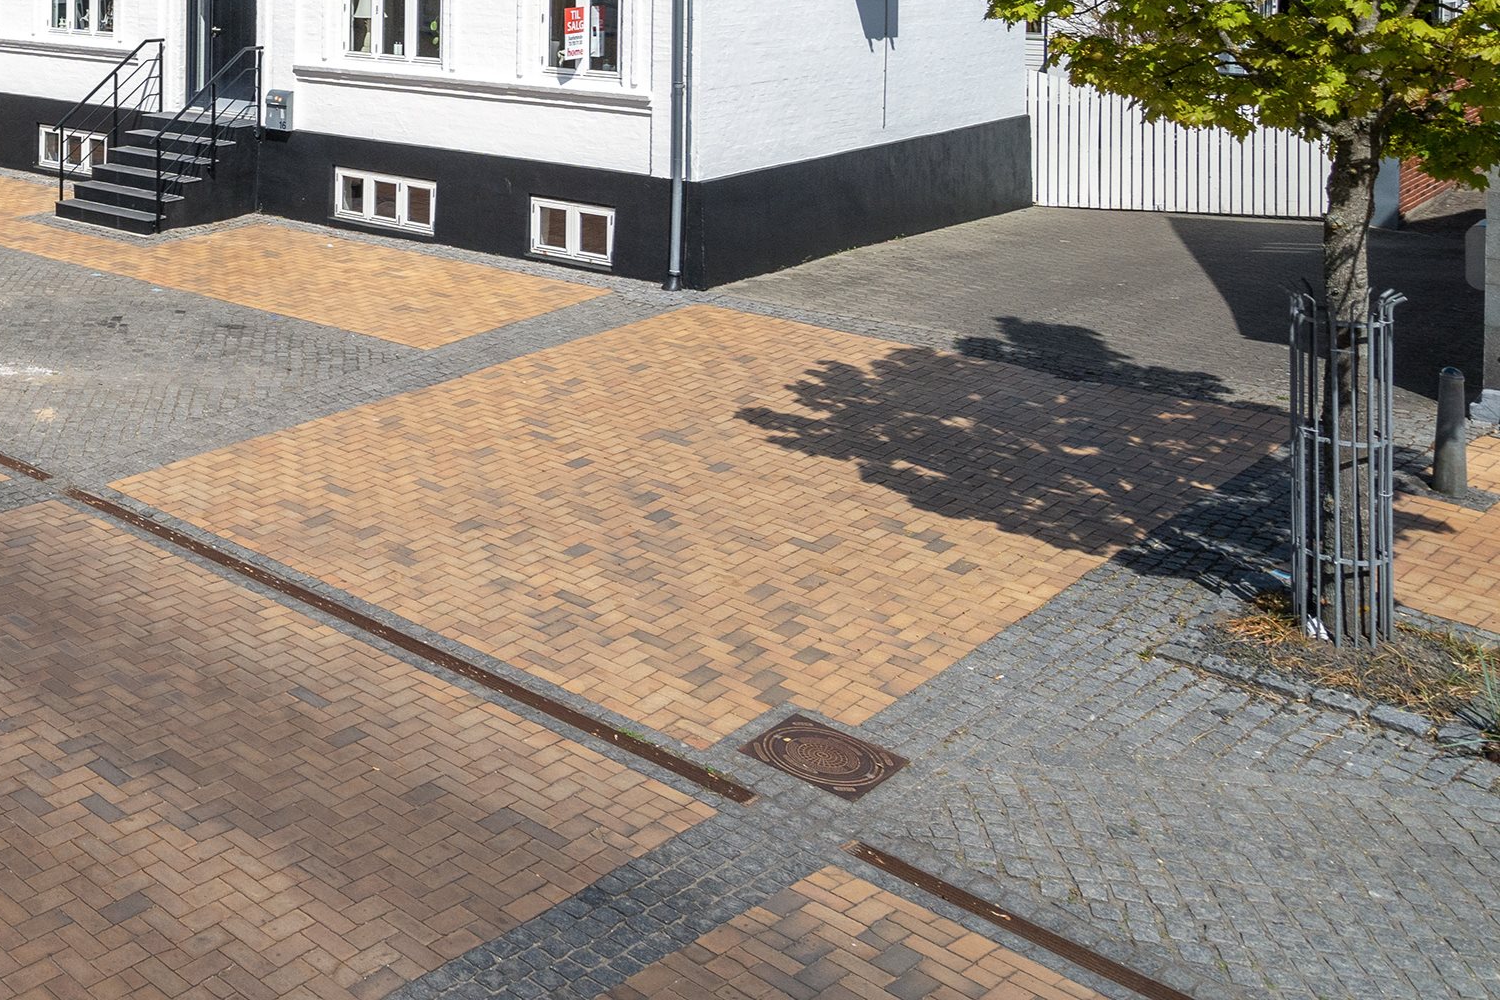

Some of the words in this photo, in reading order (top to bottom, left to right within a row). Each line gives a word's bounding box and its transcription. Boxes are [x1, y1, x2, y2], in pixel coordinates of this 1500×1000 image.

[570, 10, 581, 20] TIL
[567, 20, 584, 31] SALG
[279, 120, 287, 130] 16
